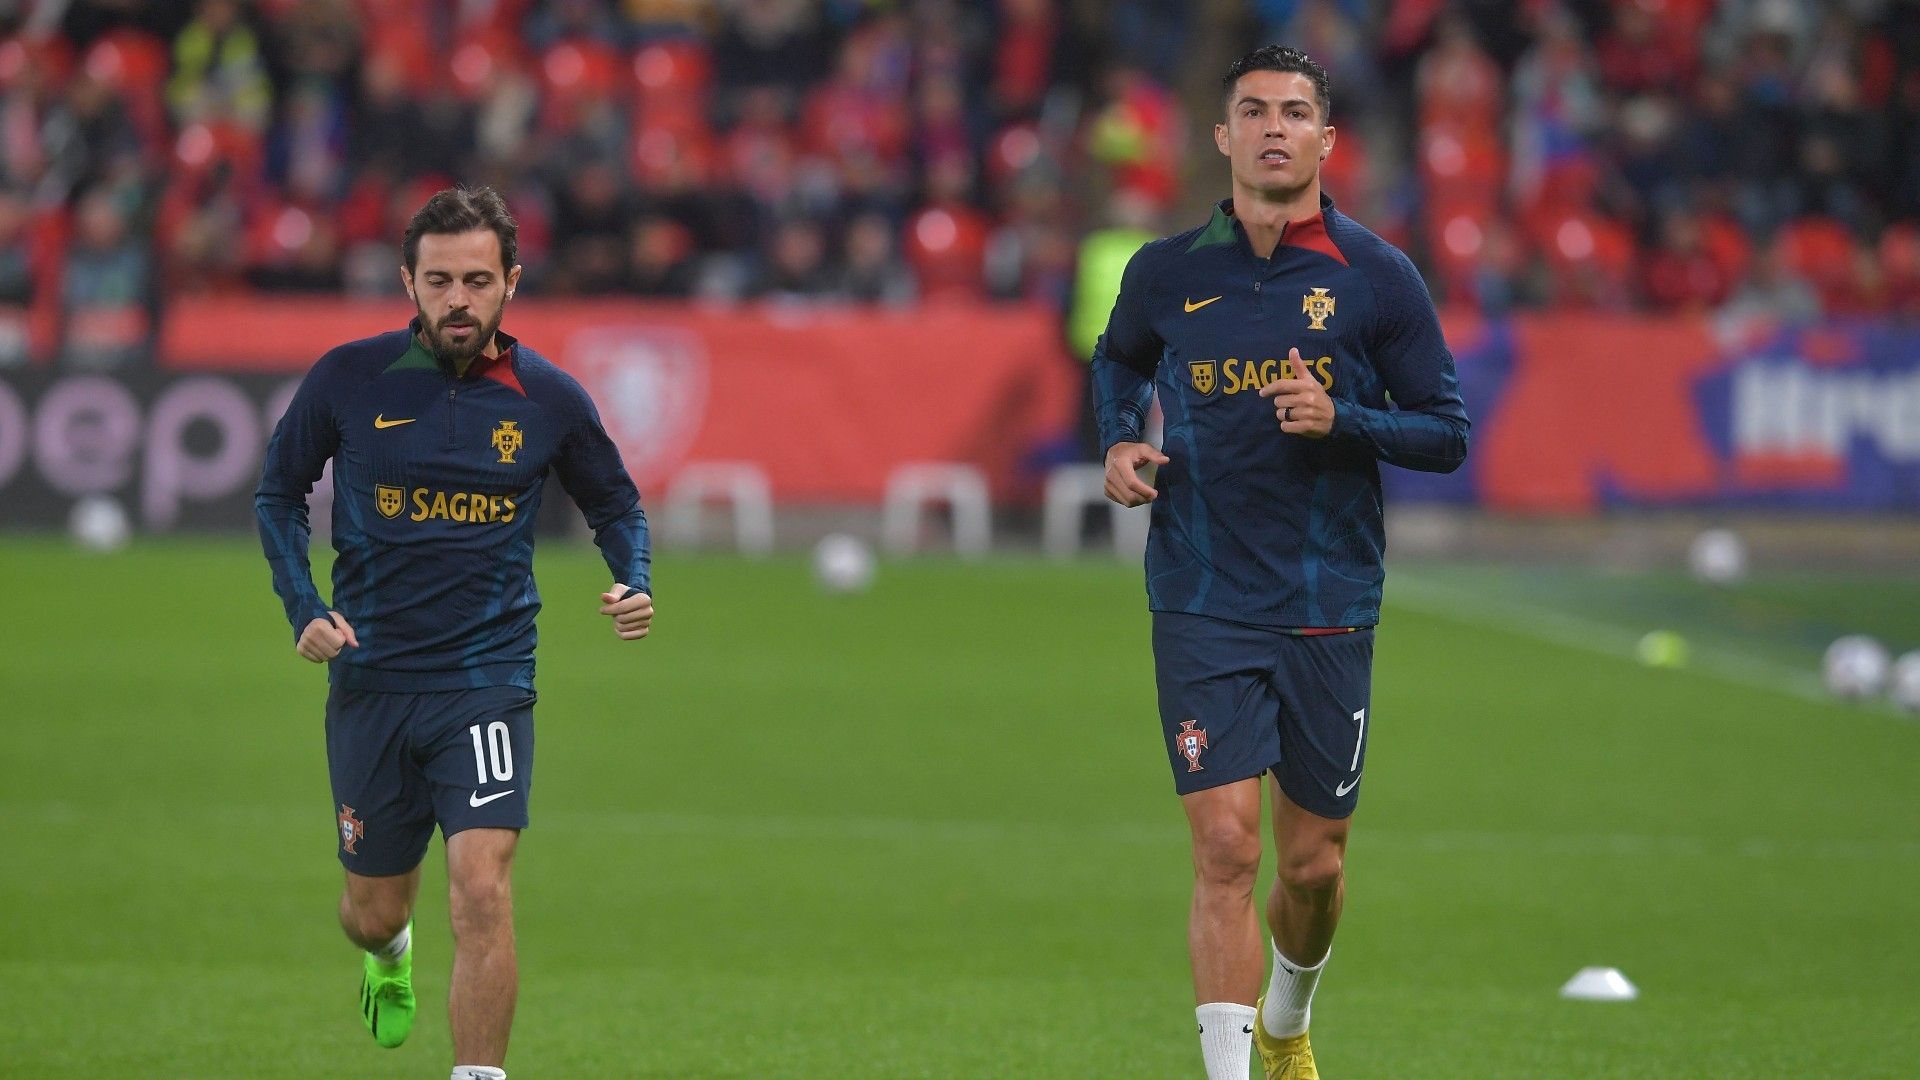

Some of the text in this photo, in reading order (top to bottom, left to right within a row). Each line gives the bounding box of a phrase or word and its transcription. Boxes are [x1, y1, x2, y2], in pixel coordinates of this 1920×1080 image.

[1222, 356, 1334, 395] SAGRS
[410, 487, 518, 523] SAGRES
[469, 721, 514, 785] 10
[1350, 707, 1365, 772] 7
